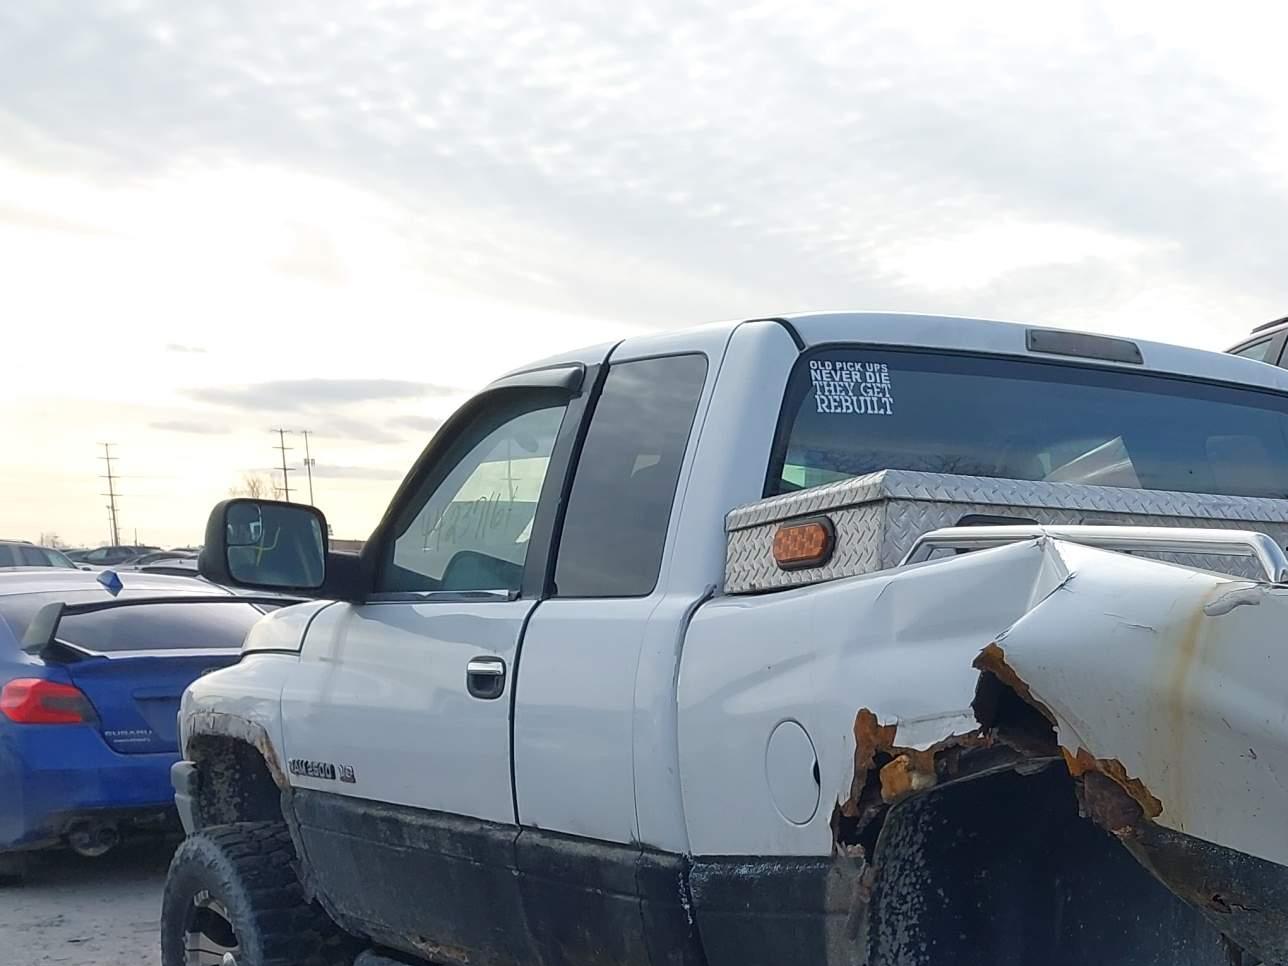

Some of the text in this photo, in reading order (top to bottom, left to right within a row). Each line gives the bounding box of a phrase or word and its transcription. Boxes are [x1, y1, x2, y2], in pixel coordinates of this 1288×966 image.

[809, 360, 888, 373] OLD PICK UPS
[810, 370, 890, 384] NEVER DIE
[812, 381, 891, 398] THEY GET
[815, 395, 893, 415] REBUILT
